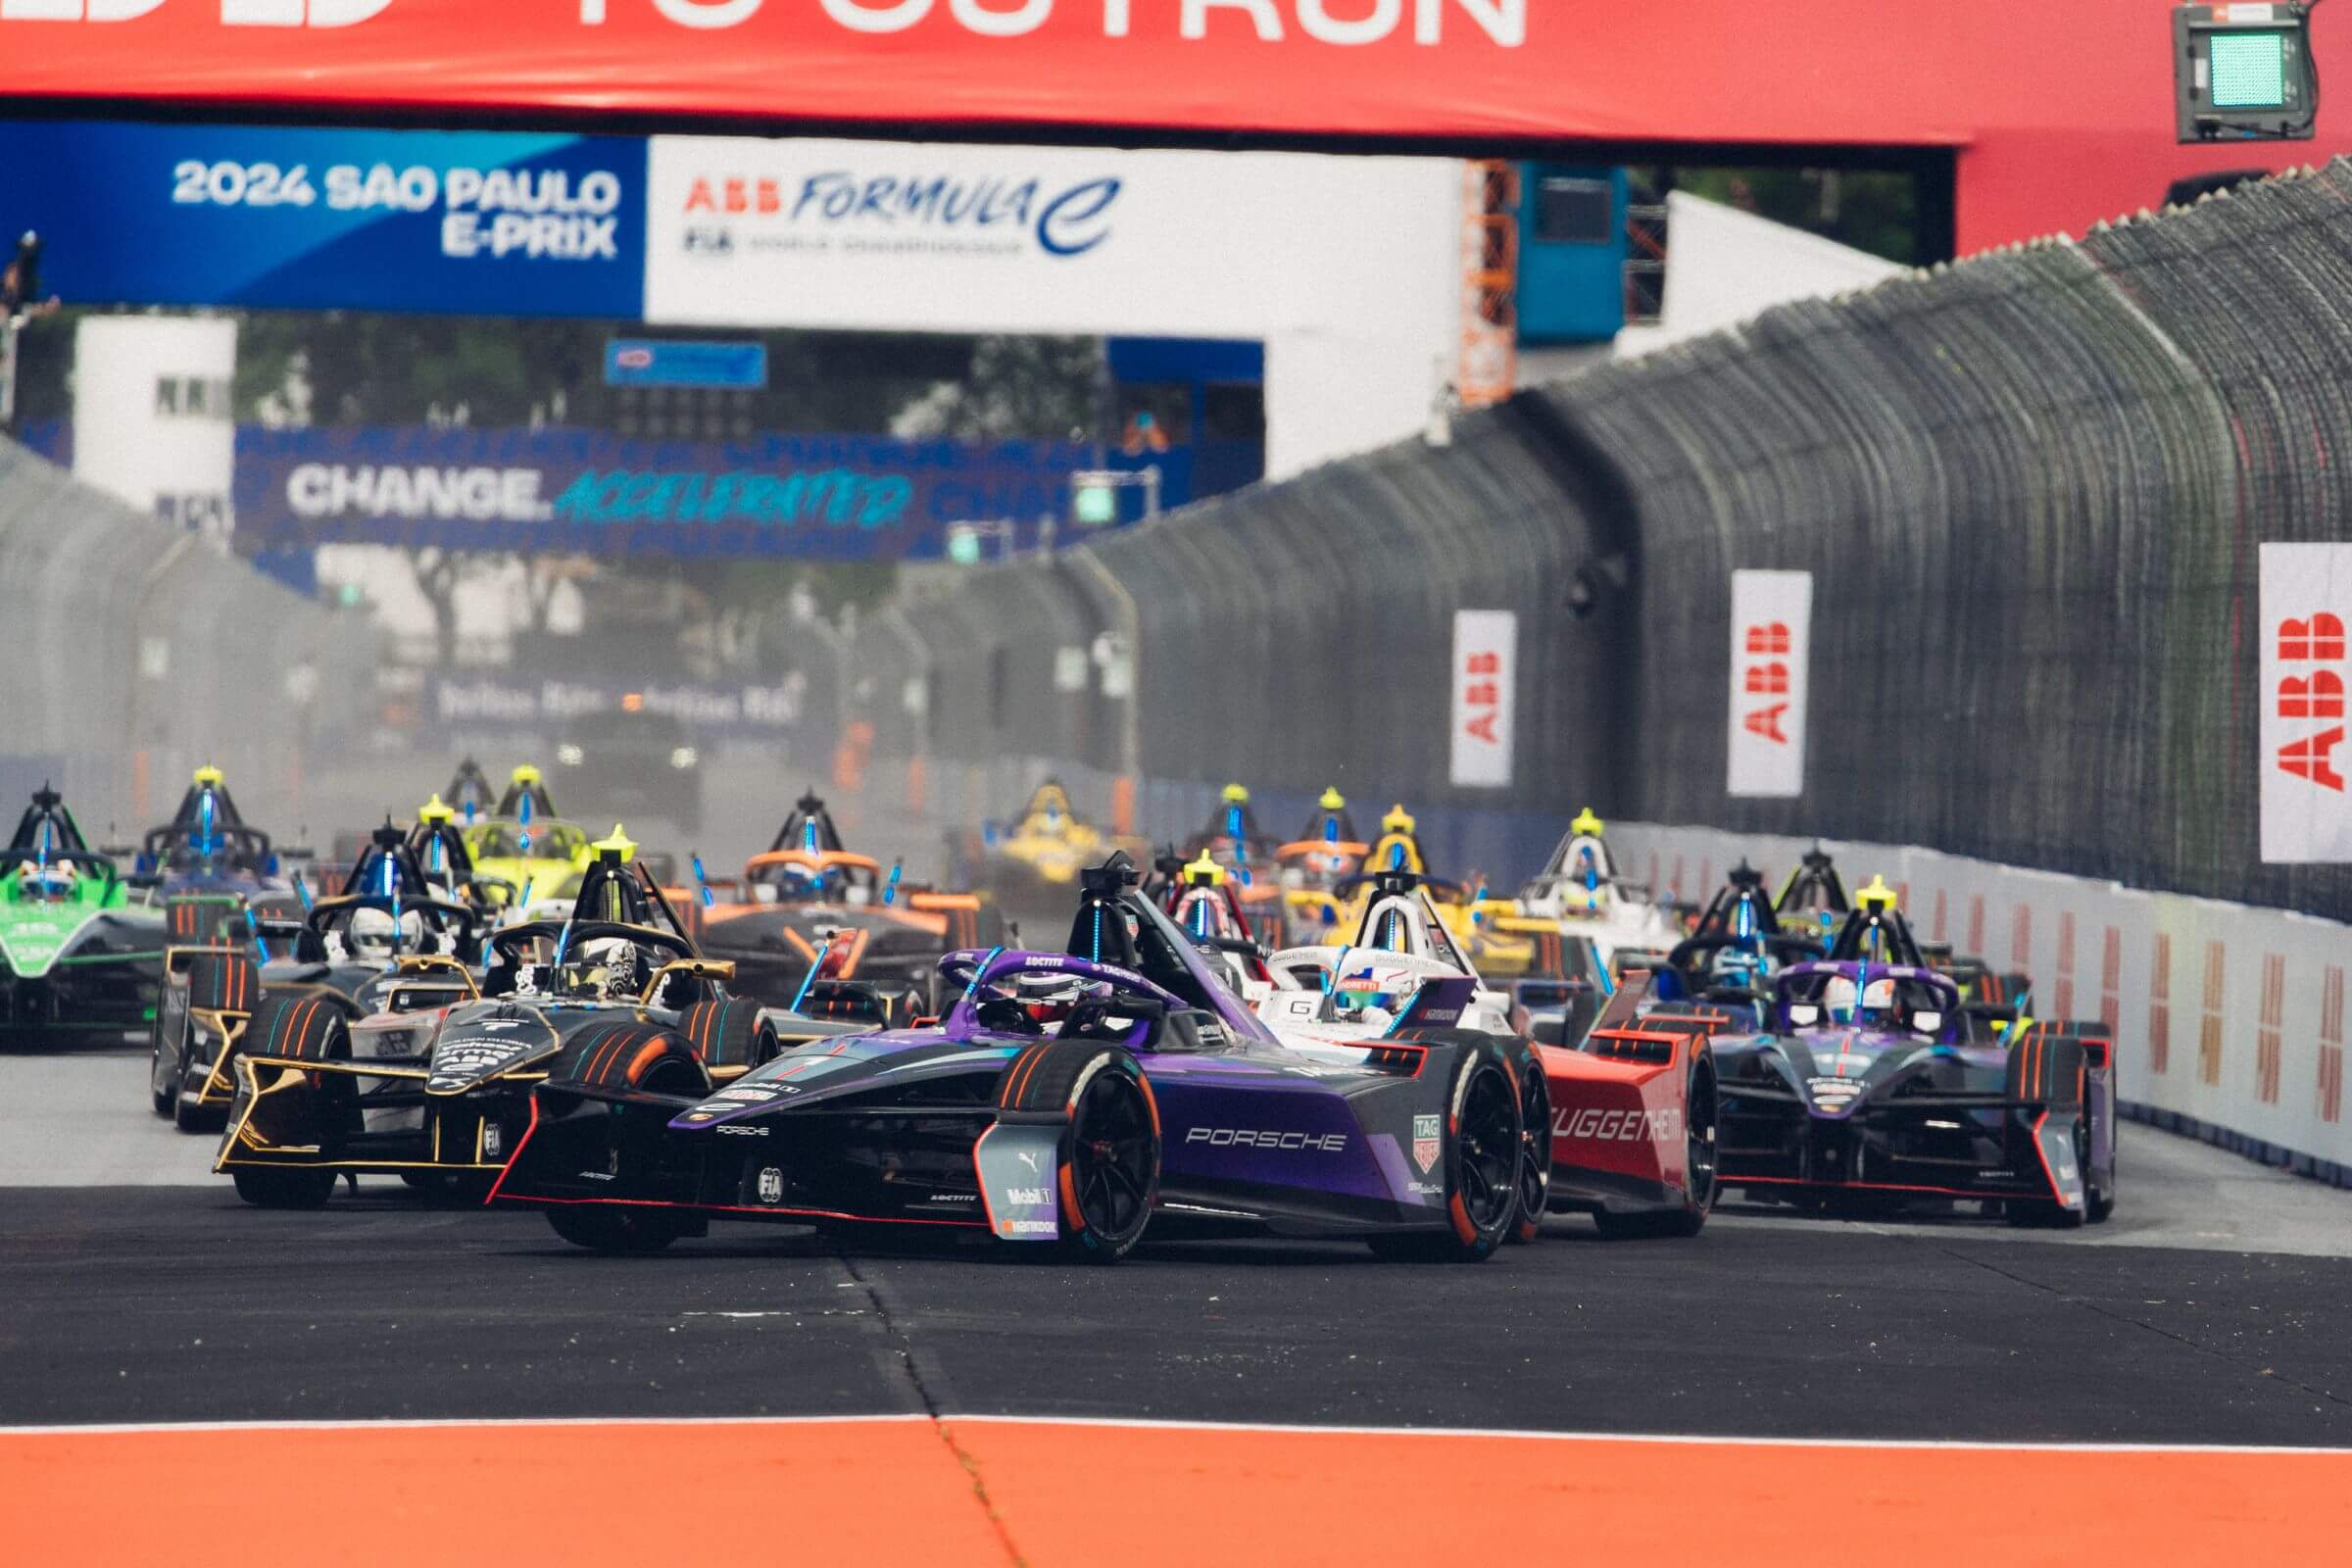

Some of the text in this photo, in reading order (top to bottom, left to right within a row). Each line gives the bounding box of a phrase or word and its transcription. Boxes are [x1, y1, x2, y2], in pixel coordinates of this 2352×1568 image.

[172, 160, 316, 207] 2024
[445, 168, 621, 215] PAULO
[685, 176, 780, 215] ABB
[791, 172, 1040, 224] FORMULA
[441, 212, 617, 258] E-PRIX
[288, 464, 555, 521] CHANGE.
[1464, 651, 1500, 745] ABB
[1743, 621, 1791, 744] ABB
[2278, 612, 2345, 792] ABB
[1025, 956, 1064, 967] LOCTITE
[716, 1125, 769, 1136] PORSCHE
[1185, 1127, 1347, 1152] PORSCHE
[1416, 1120, 1438, 1137] TAG
[1551, 1108, 1682, 1141] UGGENHEIM
[1006, 1188, 1042, 1205] Mobil
